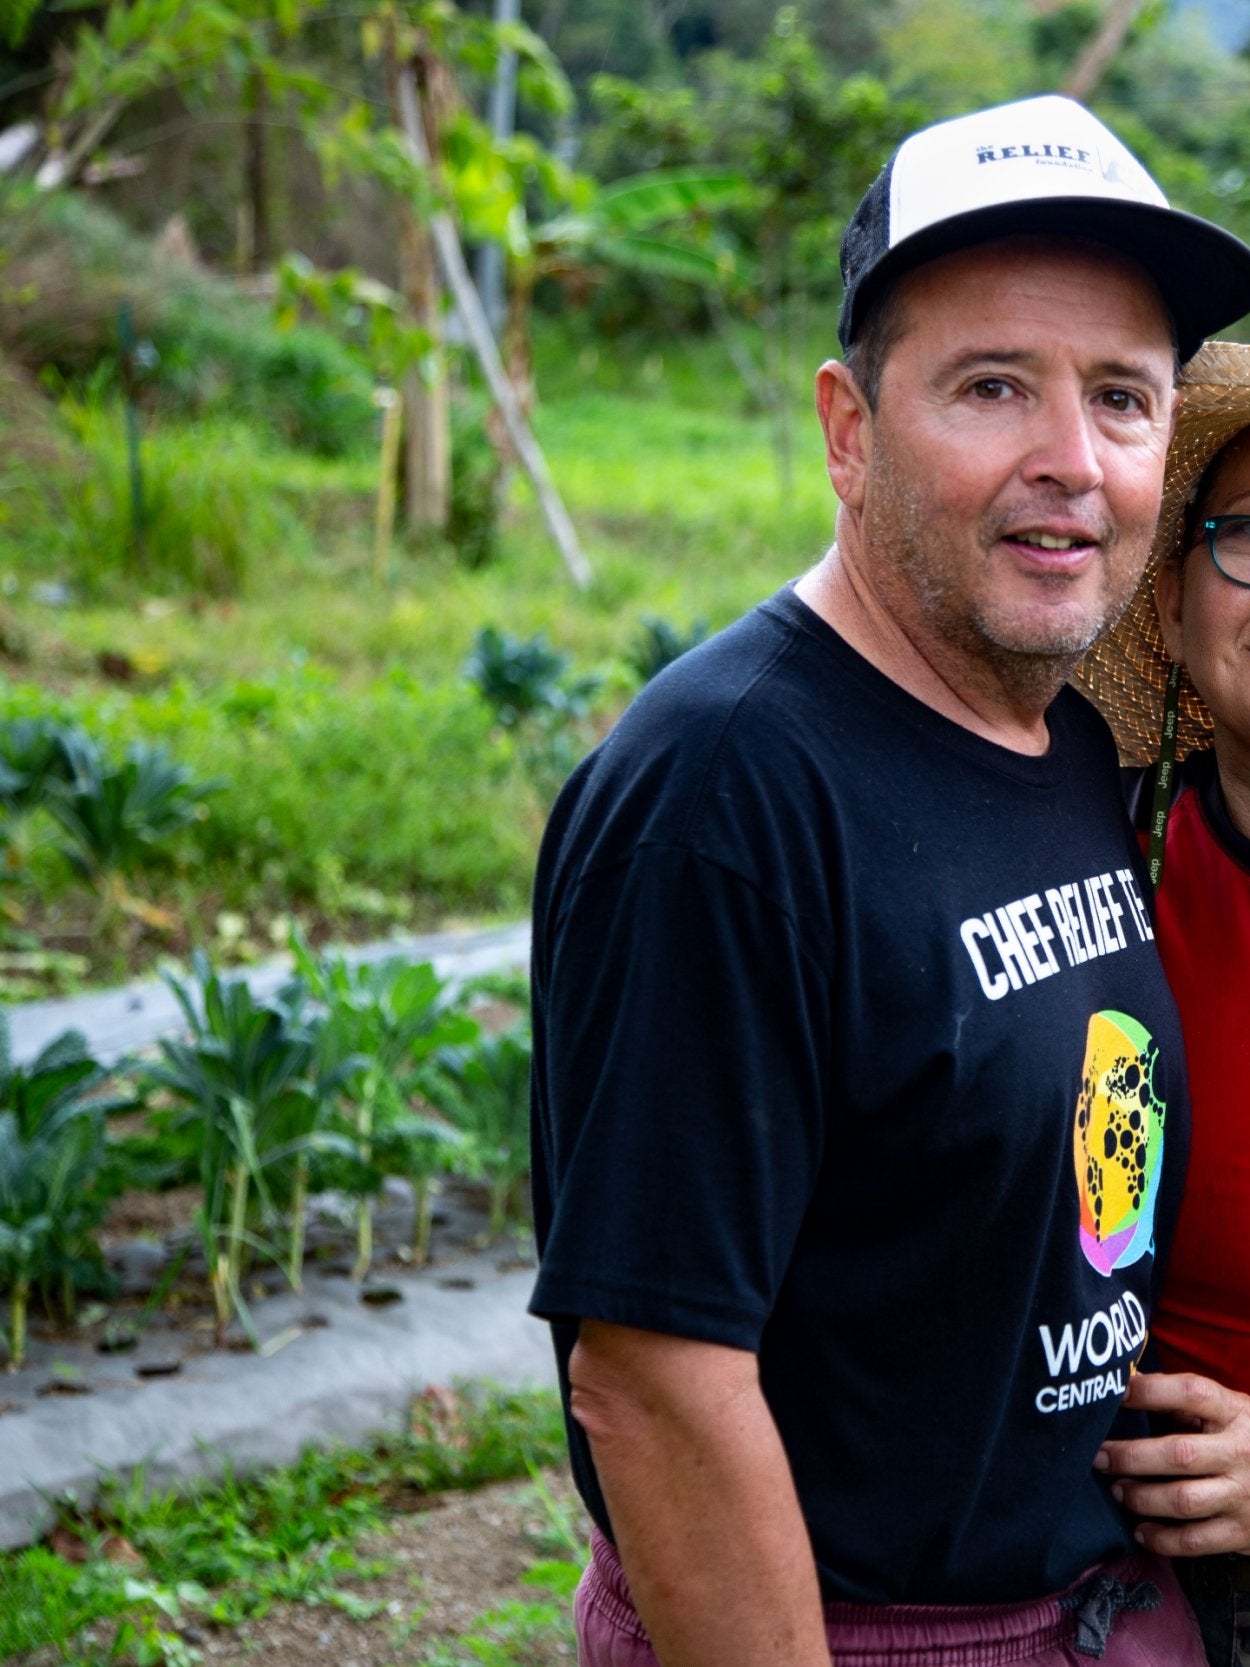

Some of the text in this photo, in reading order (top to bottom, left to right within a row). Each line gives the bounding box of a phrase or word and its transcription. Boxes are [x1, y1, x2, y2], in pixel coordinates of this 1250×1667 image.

[976, 144, 1091, 165] RELIEF
[1164, 711, 1176, 739] Jeep
[1158, 761, 1171, 789] Jeep
[1153, 811, 1166, 838] Jeep
[960, 893, 1060, 1000] CHEF
[1045, 873, 1128, 967] RELIEF
[1039, 1290, 1145, 1377] WORLD
[1035, 1367, 1126, 1413] CENTRAL
